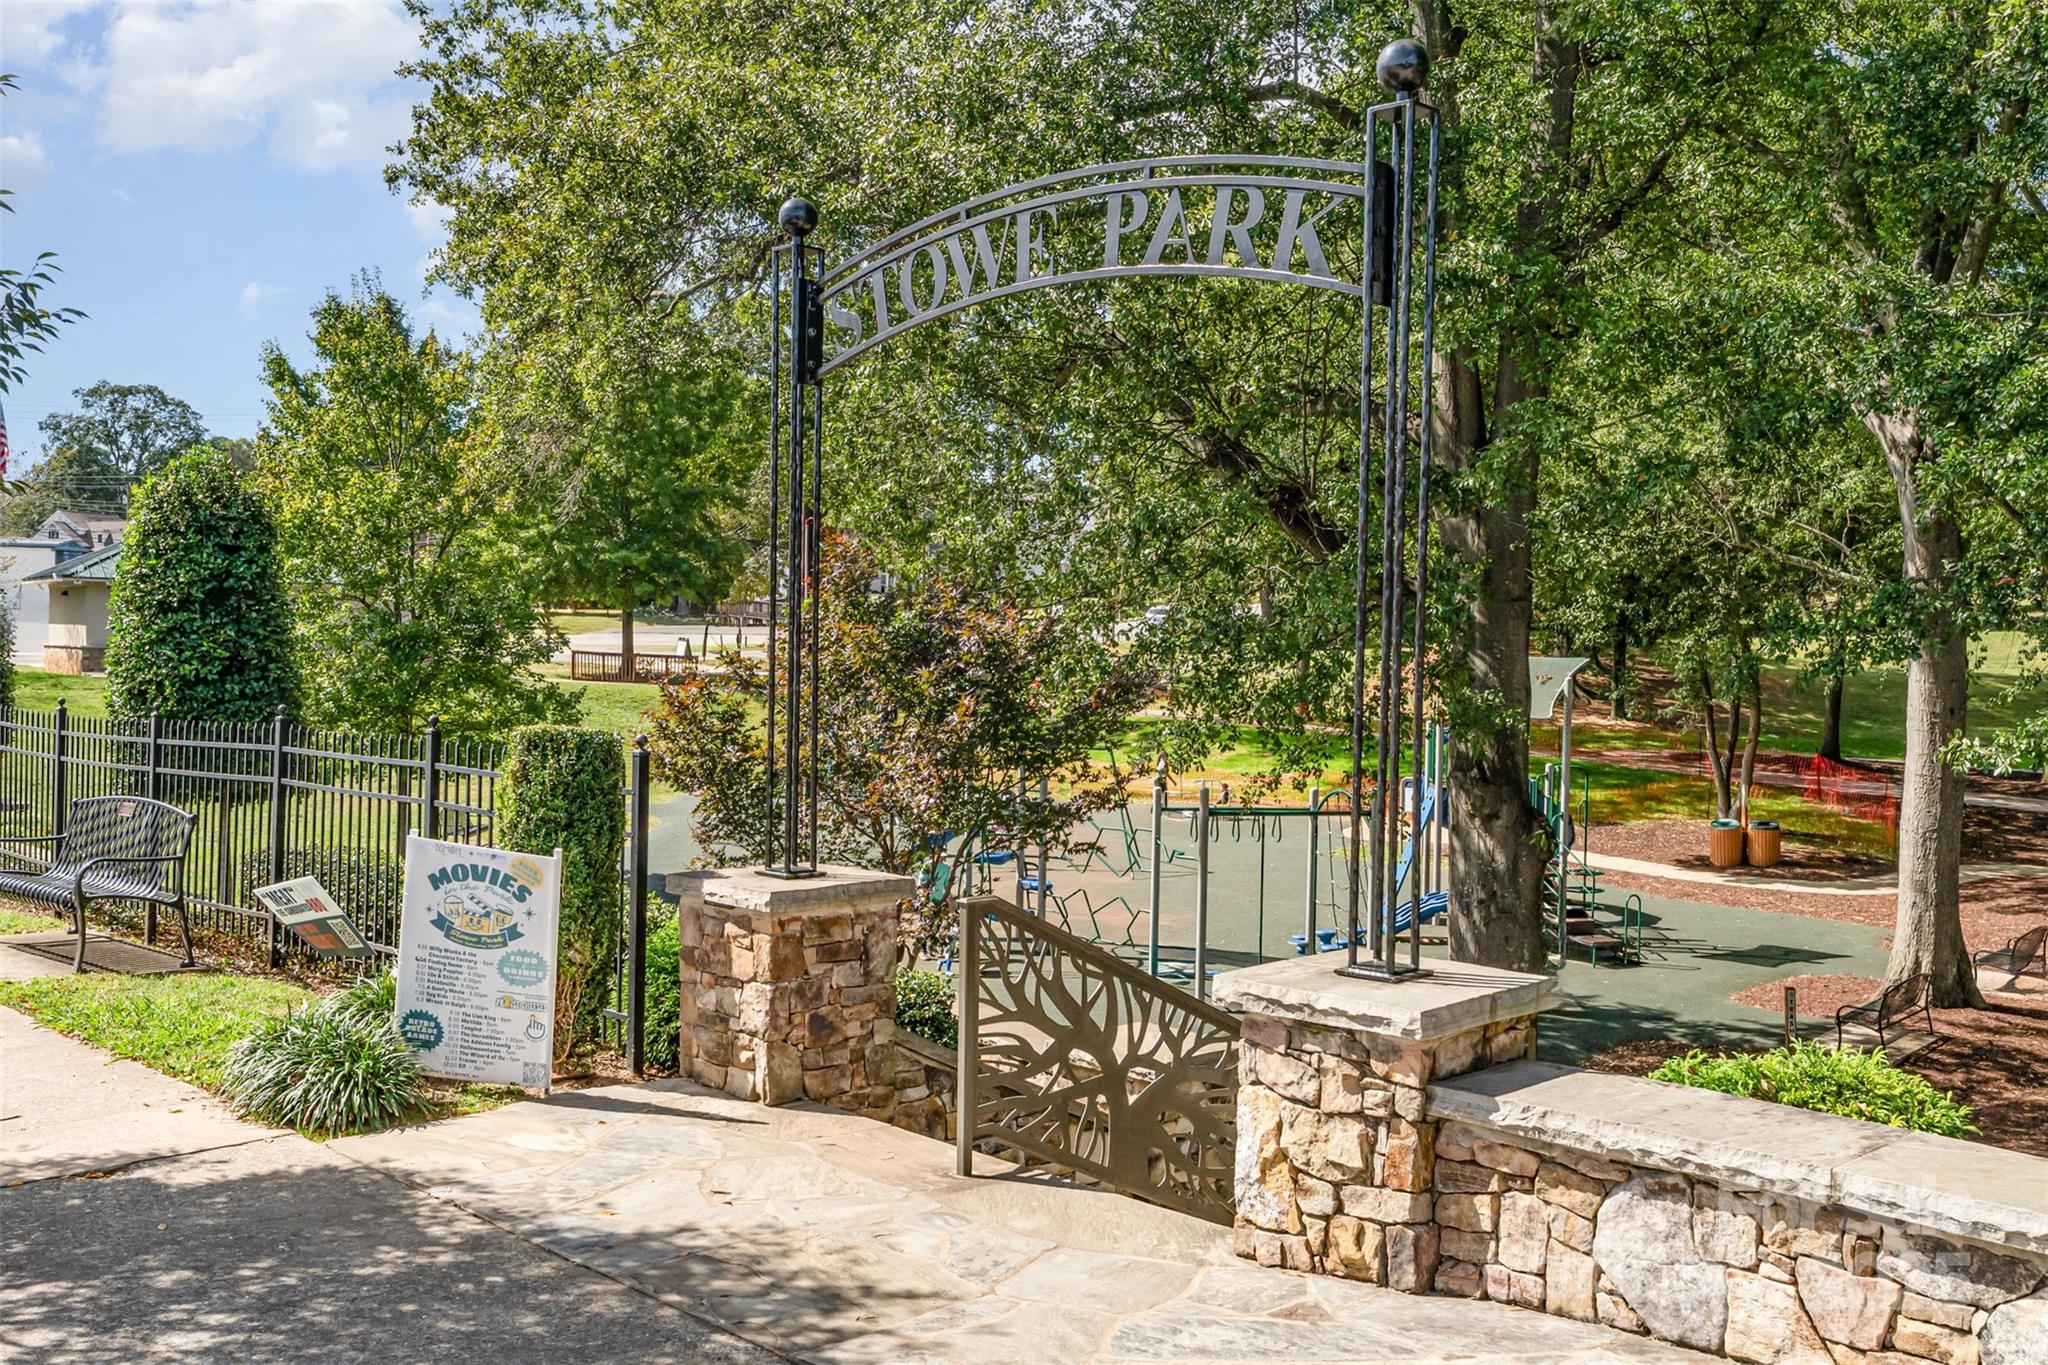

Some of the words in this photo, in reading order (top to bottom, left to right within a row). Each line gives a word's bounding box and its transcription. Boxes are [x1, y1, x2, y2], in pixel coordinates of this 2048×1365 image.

[829, 203, 1059, 354] STOWE
[1101, 185, 1350, 280] PARK
[427, 863, 533, 903] MOVIES
[460, 883, 480, 891] the
[510, 955, 538, 964] FOOD
[503, 967, 544, 977] DRINKS
[408, 1018, 435, 1028] RETRO
[405, 1025, 437, 1034] ARCADE
[407, 1031, 435, 1040] GAMES
